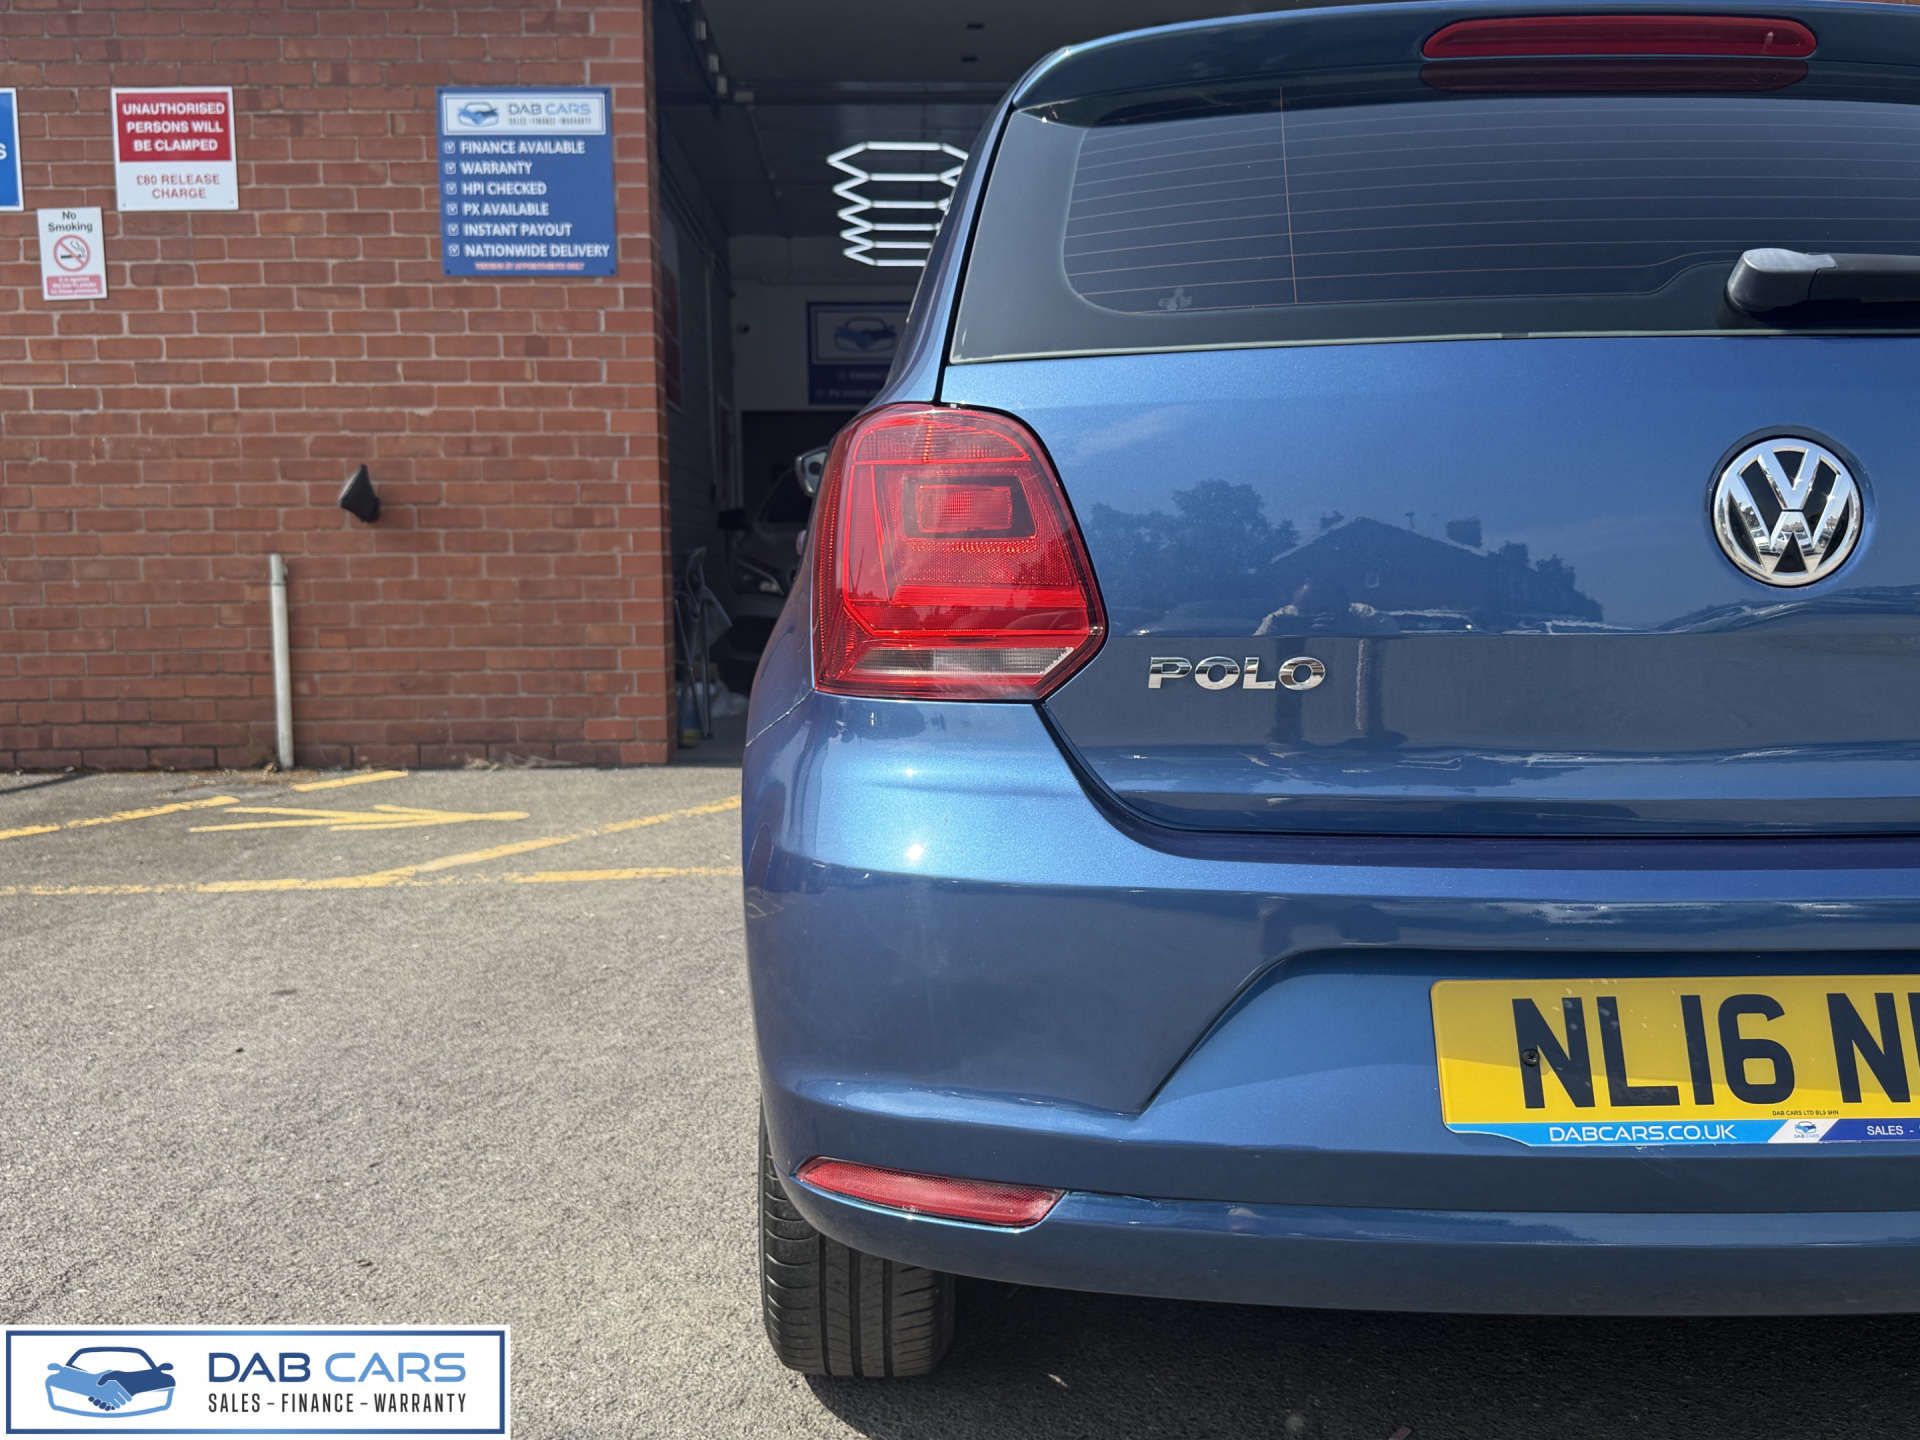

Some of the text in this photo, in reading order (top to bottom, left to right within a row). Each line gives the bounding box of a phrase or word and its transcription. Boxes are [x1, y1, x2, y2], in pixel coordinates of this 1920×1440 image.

[122, 102, 225, 116] UNAUTHORISED
[508, 103, 592, 115] DAB CARS
[126, 121, 224, 134] PERSONS WILL
[133, 139, 218, 152] BE CLAMPED
[460, 141, 585, 154] FINANCE AVAILABLE
[460, 162, 533, 175] WARRANTY
[161, 173, 220, 185] RELEASE
[151, 188, 207, 200] CHARGE
[461, 182, 547, 195] HPI CHECKED
[62, 211, 77, 220] No
[462, 203, 549, 216] PX AVAILABLE
[48, 222, 93, 233] Smoking
[463, 223, 573, 236] INSTANT PAYOUT
[464, 244, 610, 257] NATIONWIDE DELIVERY
[1148, 656, 1326, 690] POLO
[1512, 992, 1920, 1109] NL16 N
[1549, 1124, 1736, 1142] DABCARS.CO.UK
[1866, 1125, 1904, 1136] SALES
